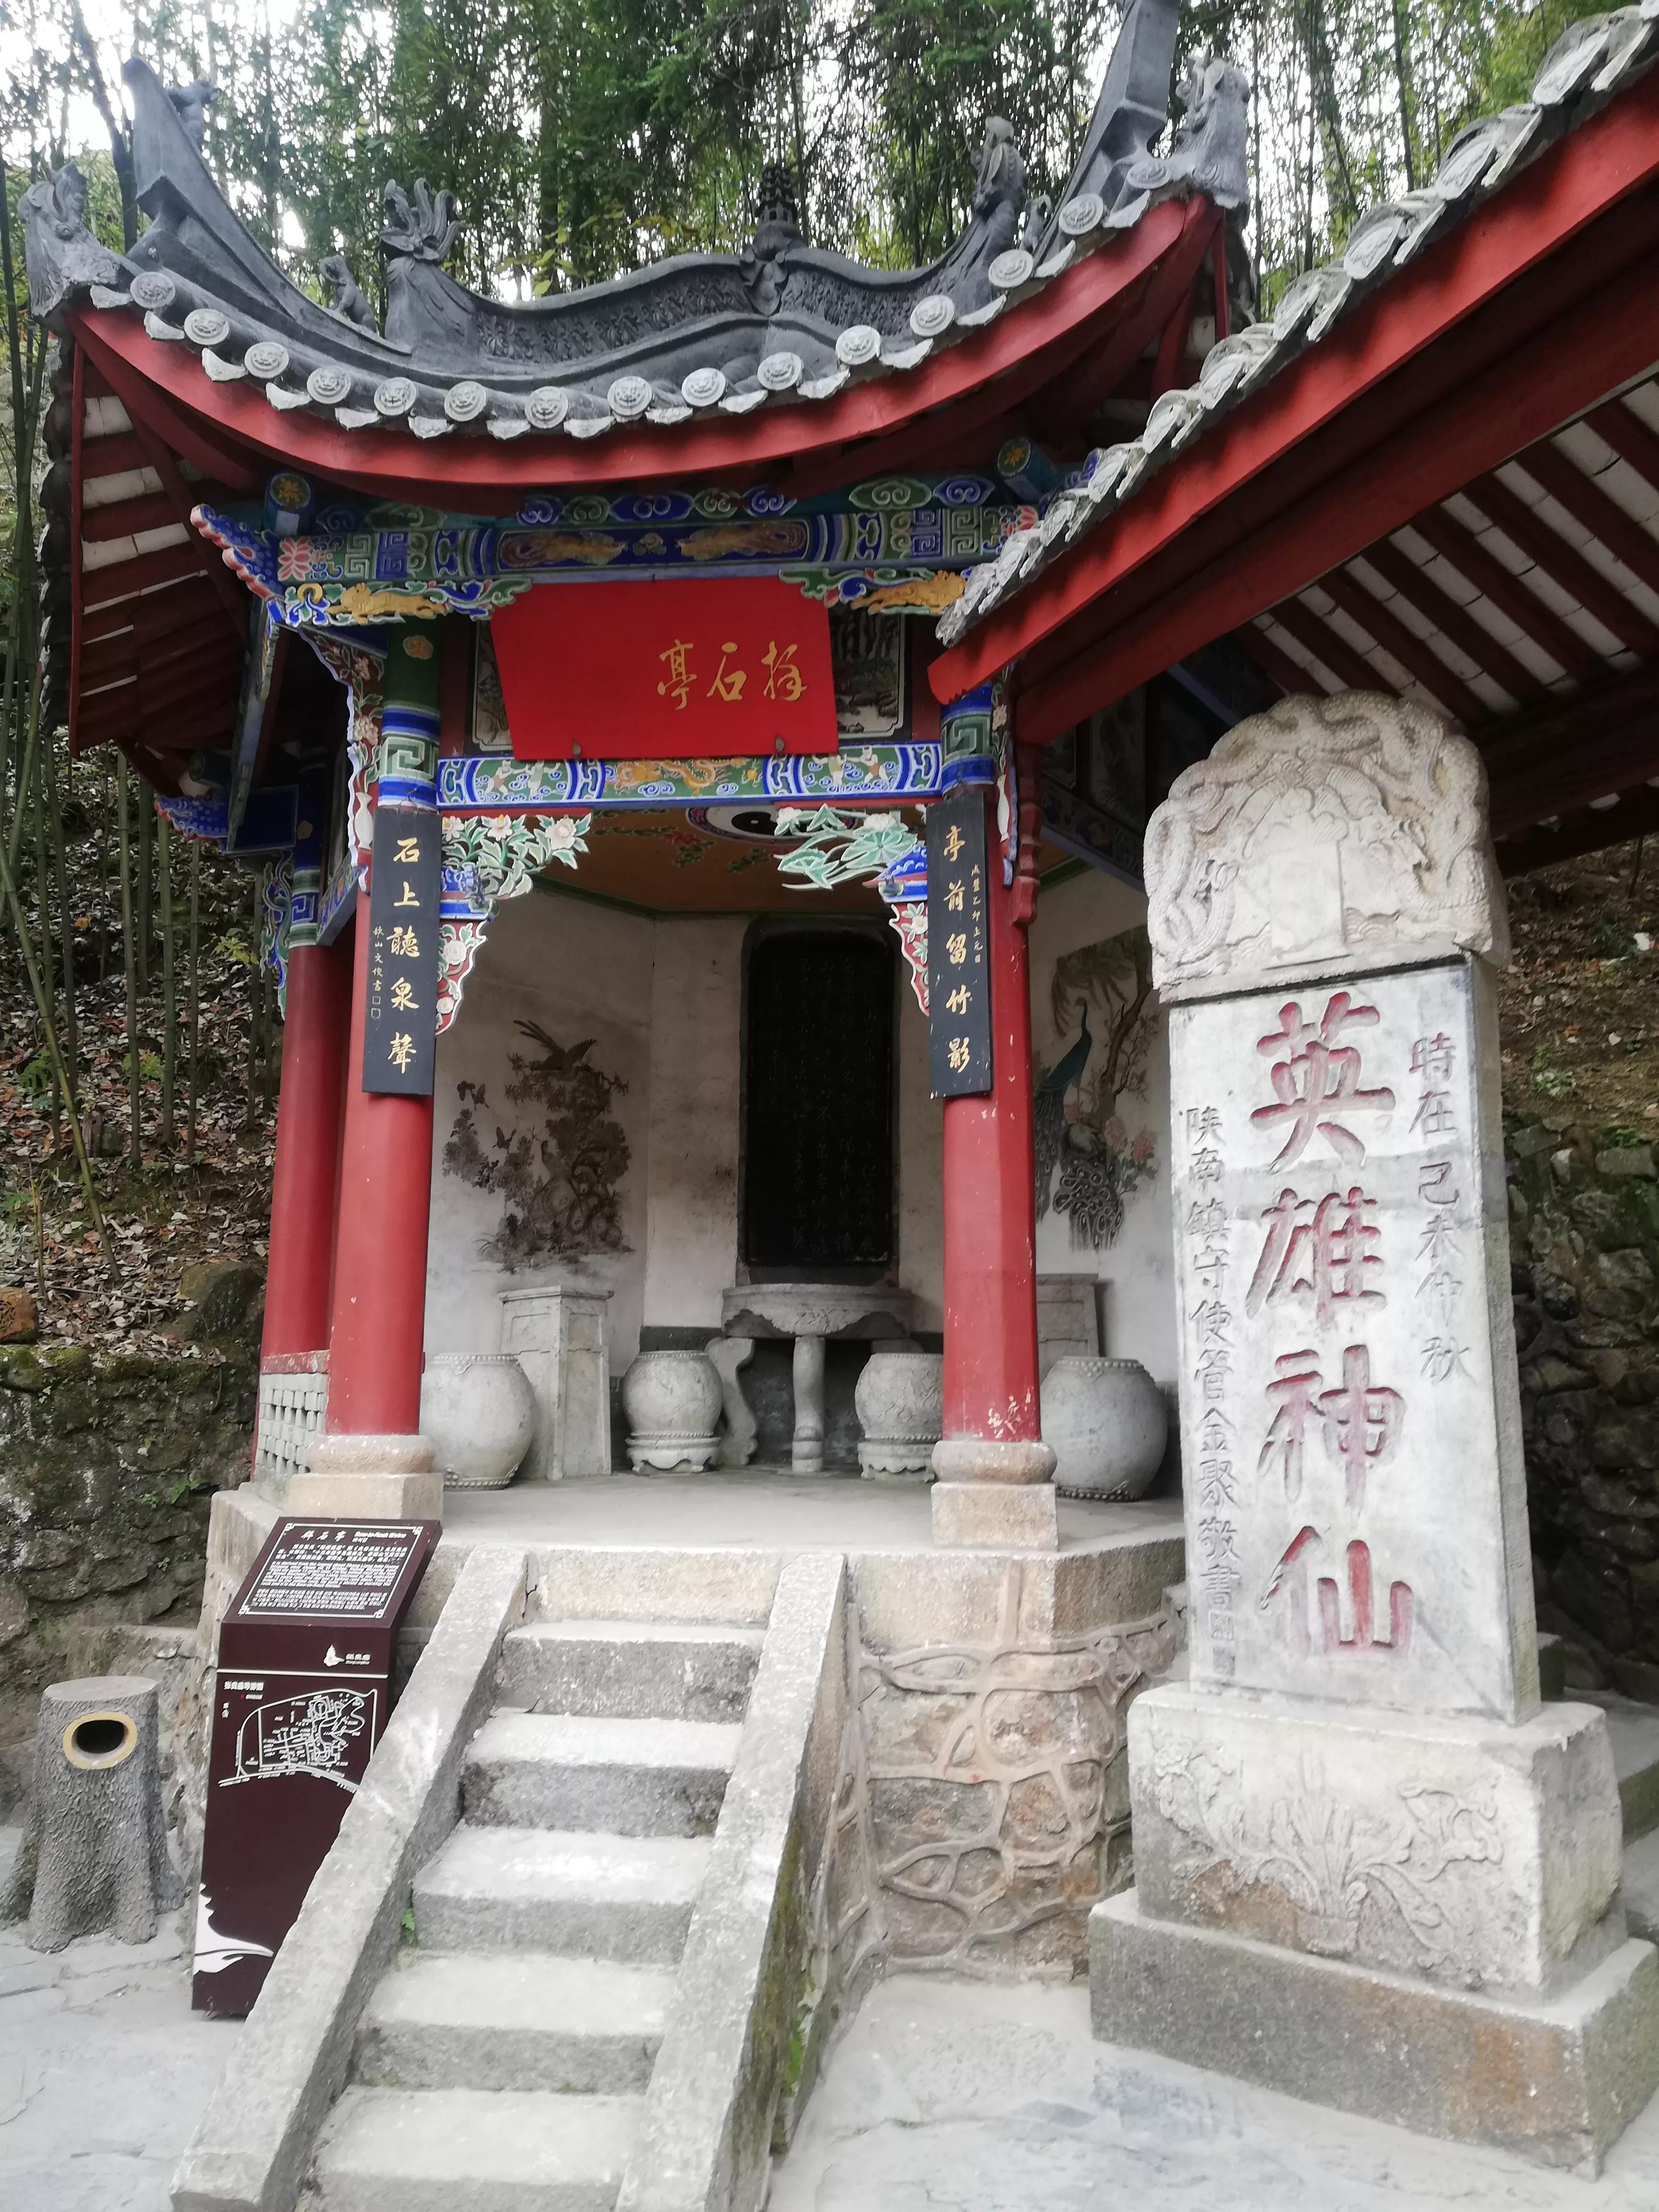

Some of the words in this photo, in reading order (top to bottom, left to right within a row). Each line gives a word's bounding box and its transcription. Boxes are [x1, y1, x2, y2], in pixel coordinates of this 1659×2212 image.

[386, 837, 420, 1074] 石上聽泉聲
[1246, 991, 1414, 1661] 英雄神仙
